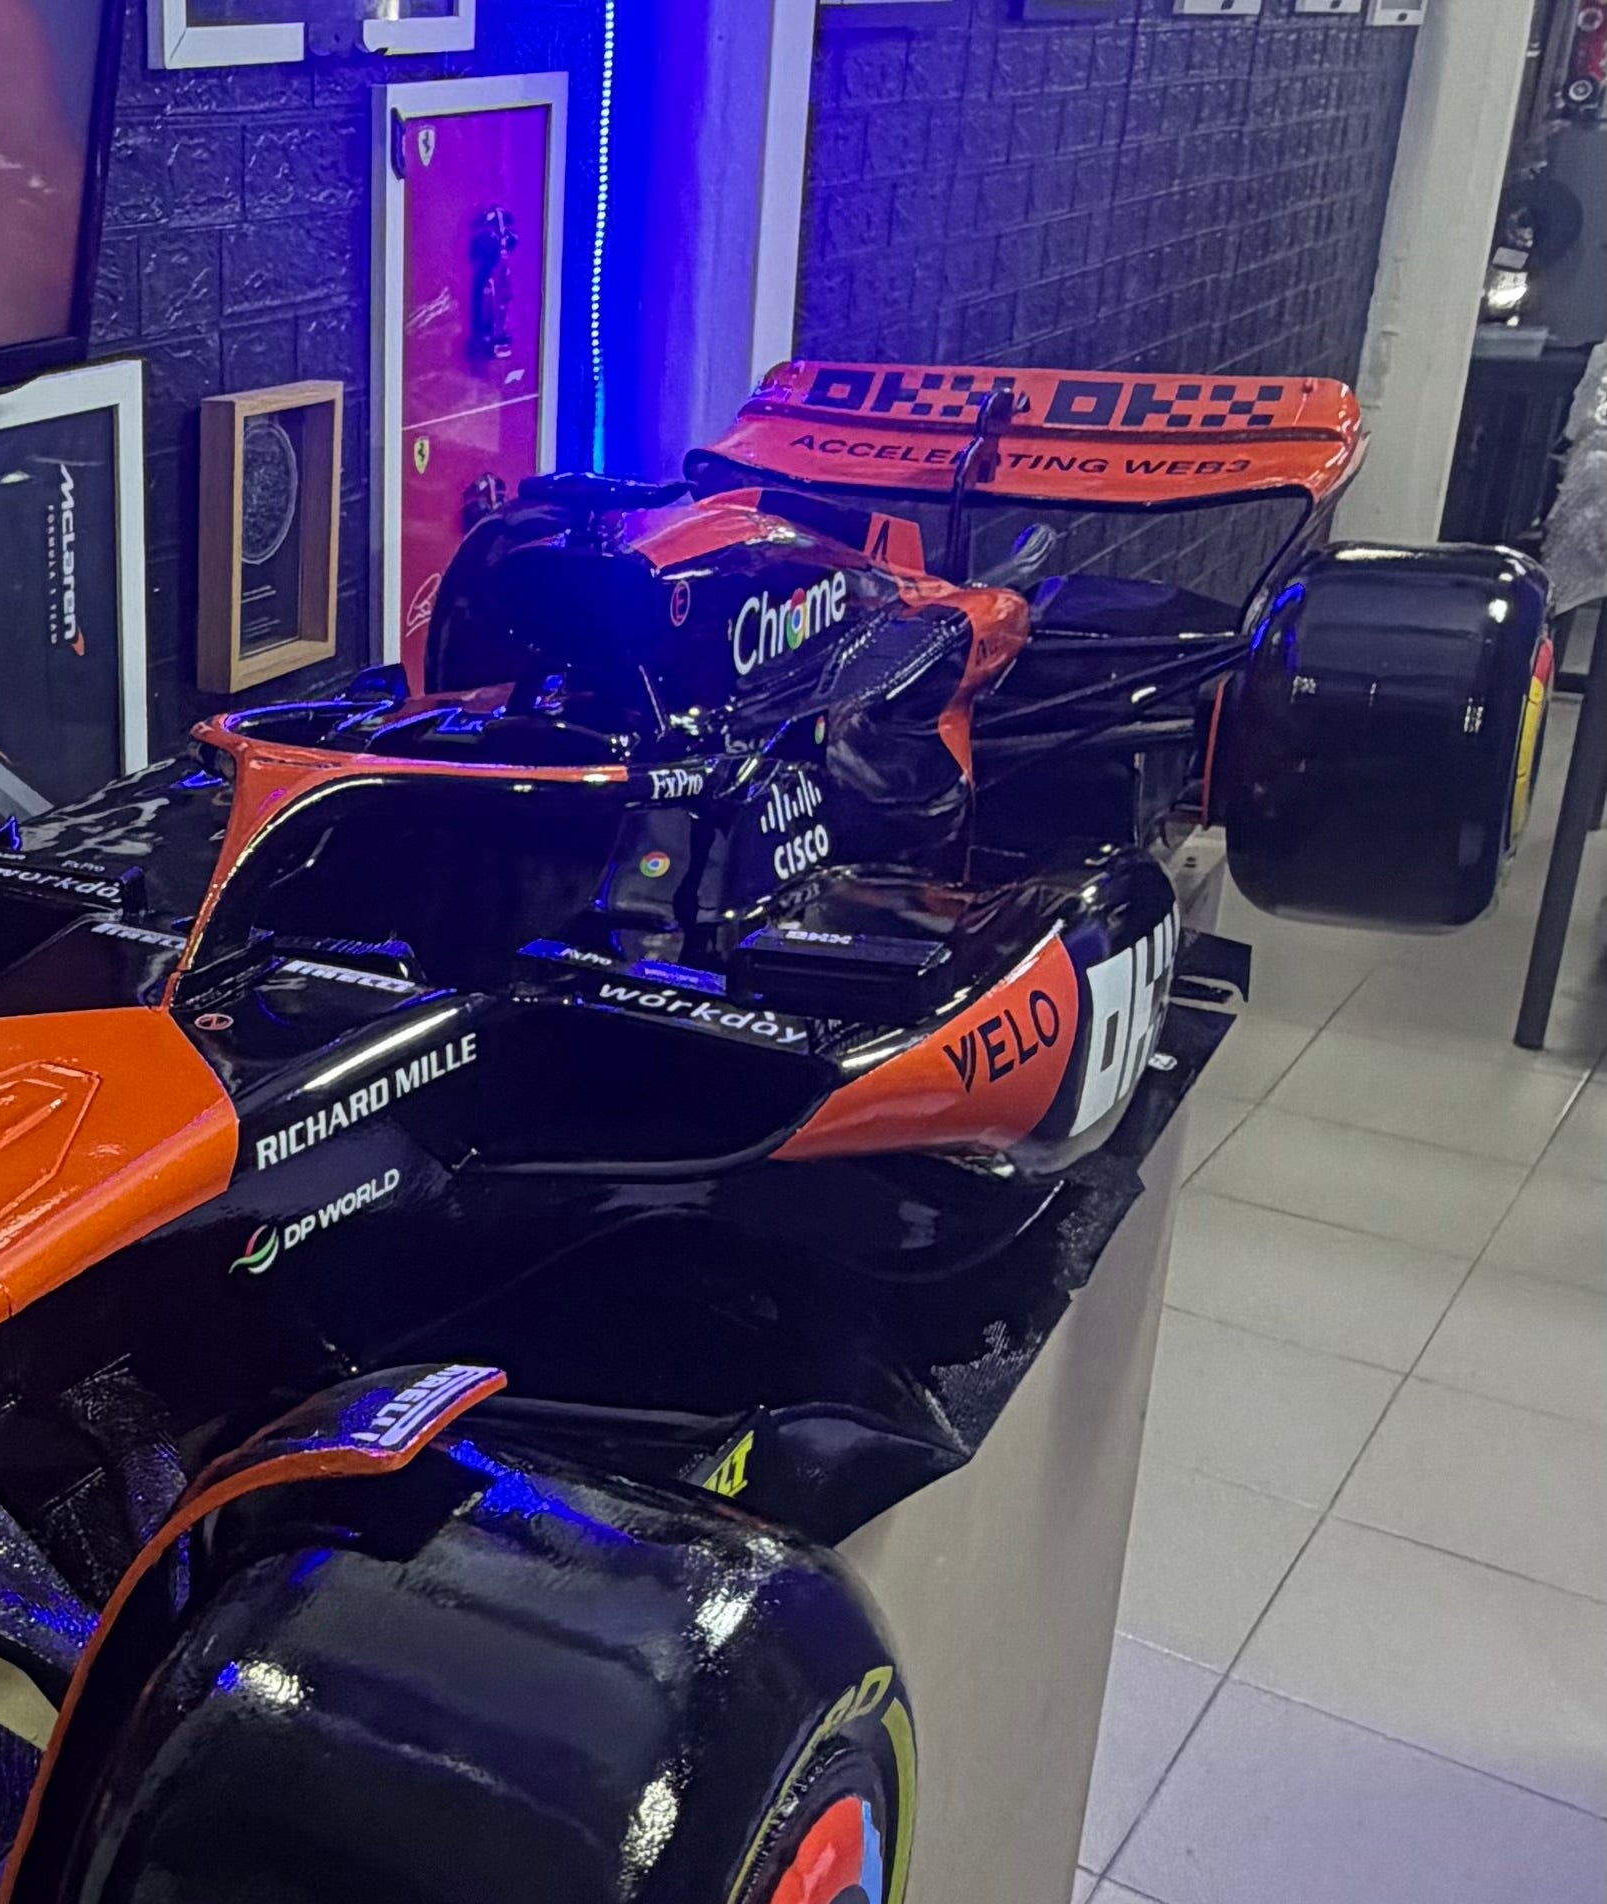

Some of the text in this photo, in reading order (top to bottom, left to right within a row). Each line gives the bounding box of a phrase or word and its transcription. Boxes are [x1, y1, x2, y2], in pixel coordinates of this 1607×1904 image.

[790, 433, 1253, 476] ACCELETING WEB3
[60, 462, 76, 640] McLaren
[733, 570, 847, 676] Chrome
[649, 767, 704, 800] FxPro
[599, 983, 808, 1044] workday
[942, 990, 1060, 1094] VELO
[255, 1032, 478, 1171] RICHARD MILLE
[283, 1167, 401, 1251] DP WORLD
